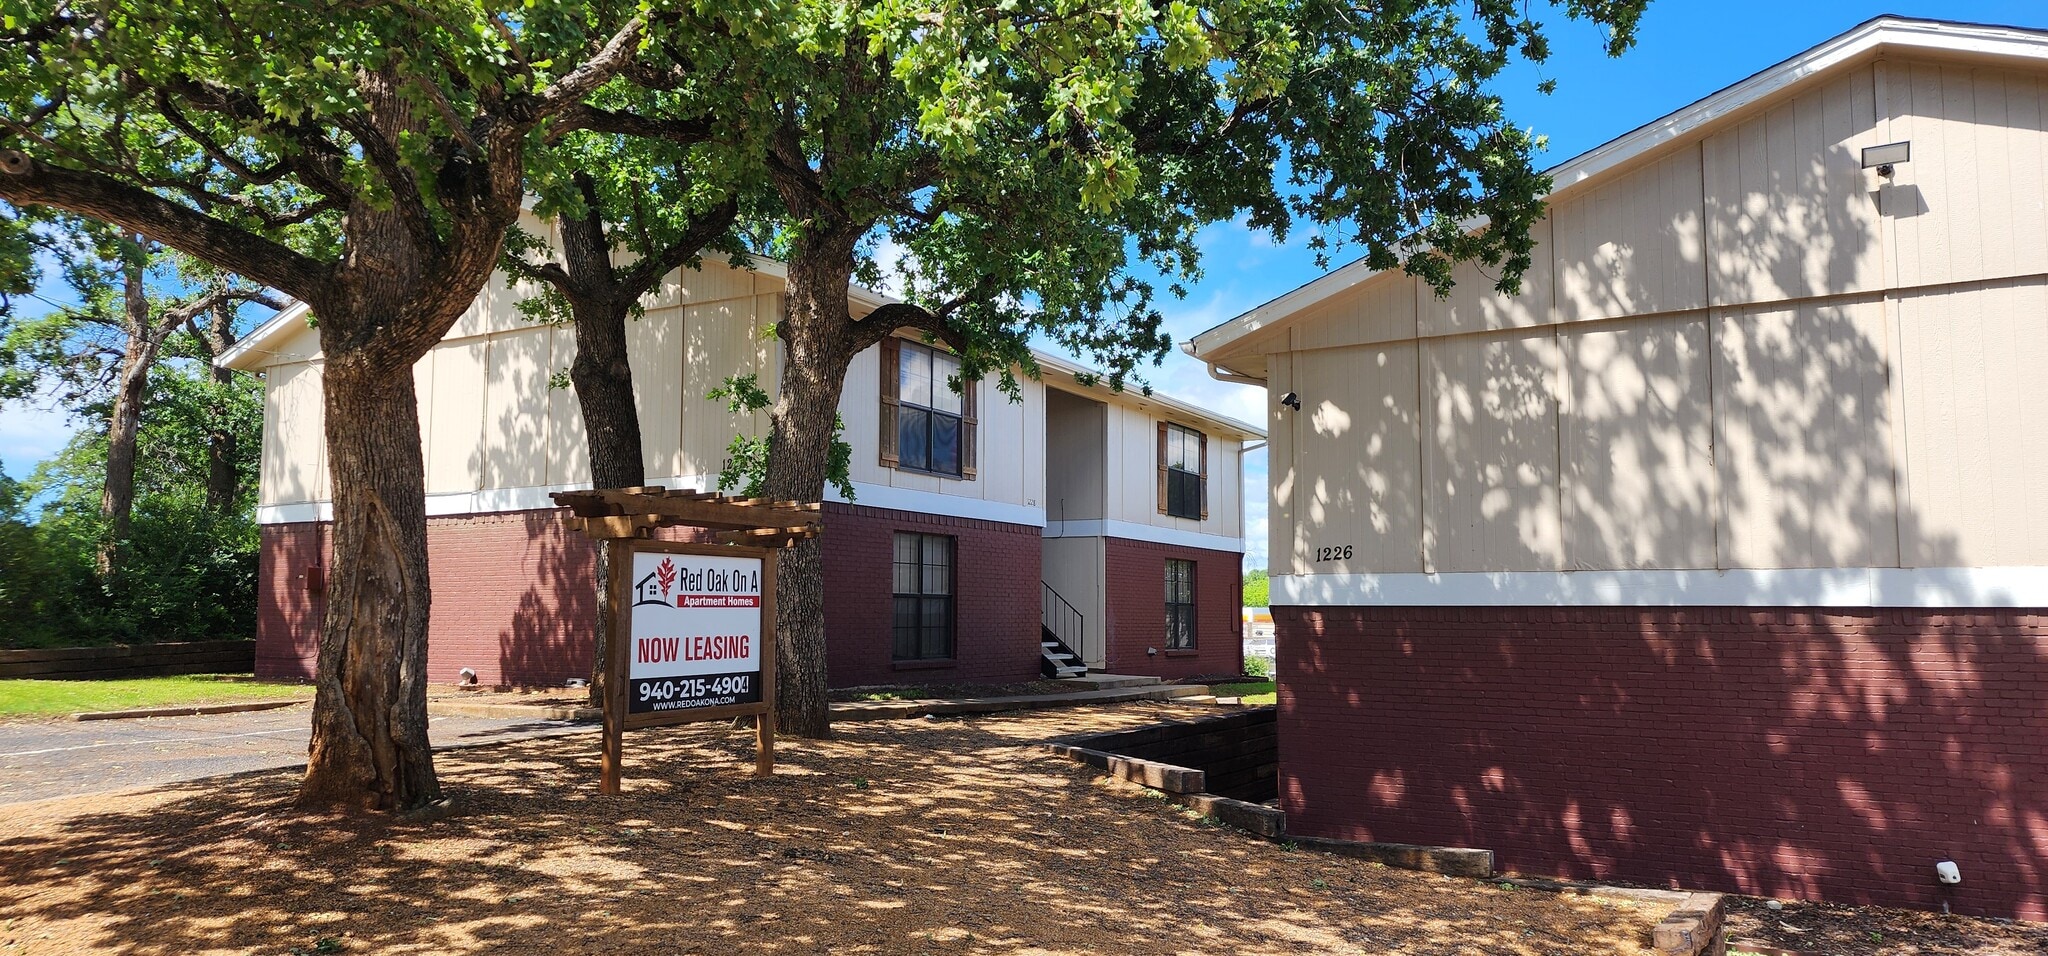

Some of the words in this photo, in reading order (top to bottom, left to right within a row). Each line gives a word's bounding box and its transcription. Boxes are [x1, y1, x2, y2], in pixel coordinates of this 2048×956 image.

[1316, 544, 1353, 563] 1226
[680, 567, 702, 592] Red
[707, 568, 728, 593] Oak
[732, 569, 747, 593] On
[750, 570, 758, 593] A
[684, 595, 726, 607] Apartment
[727, 596, 754, 606] Homes
[638, 637, 680, 664] NOW
[684, 635, 750, 661] LEASING
[639, 675, 749, 702] 940-215-4904
[652, 696, 736, 711] WWW.REDOAKONA.COM
